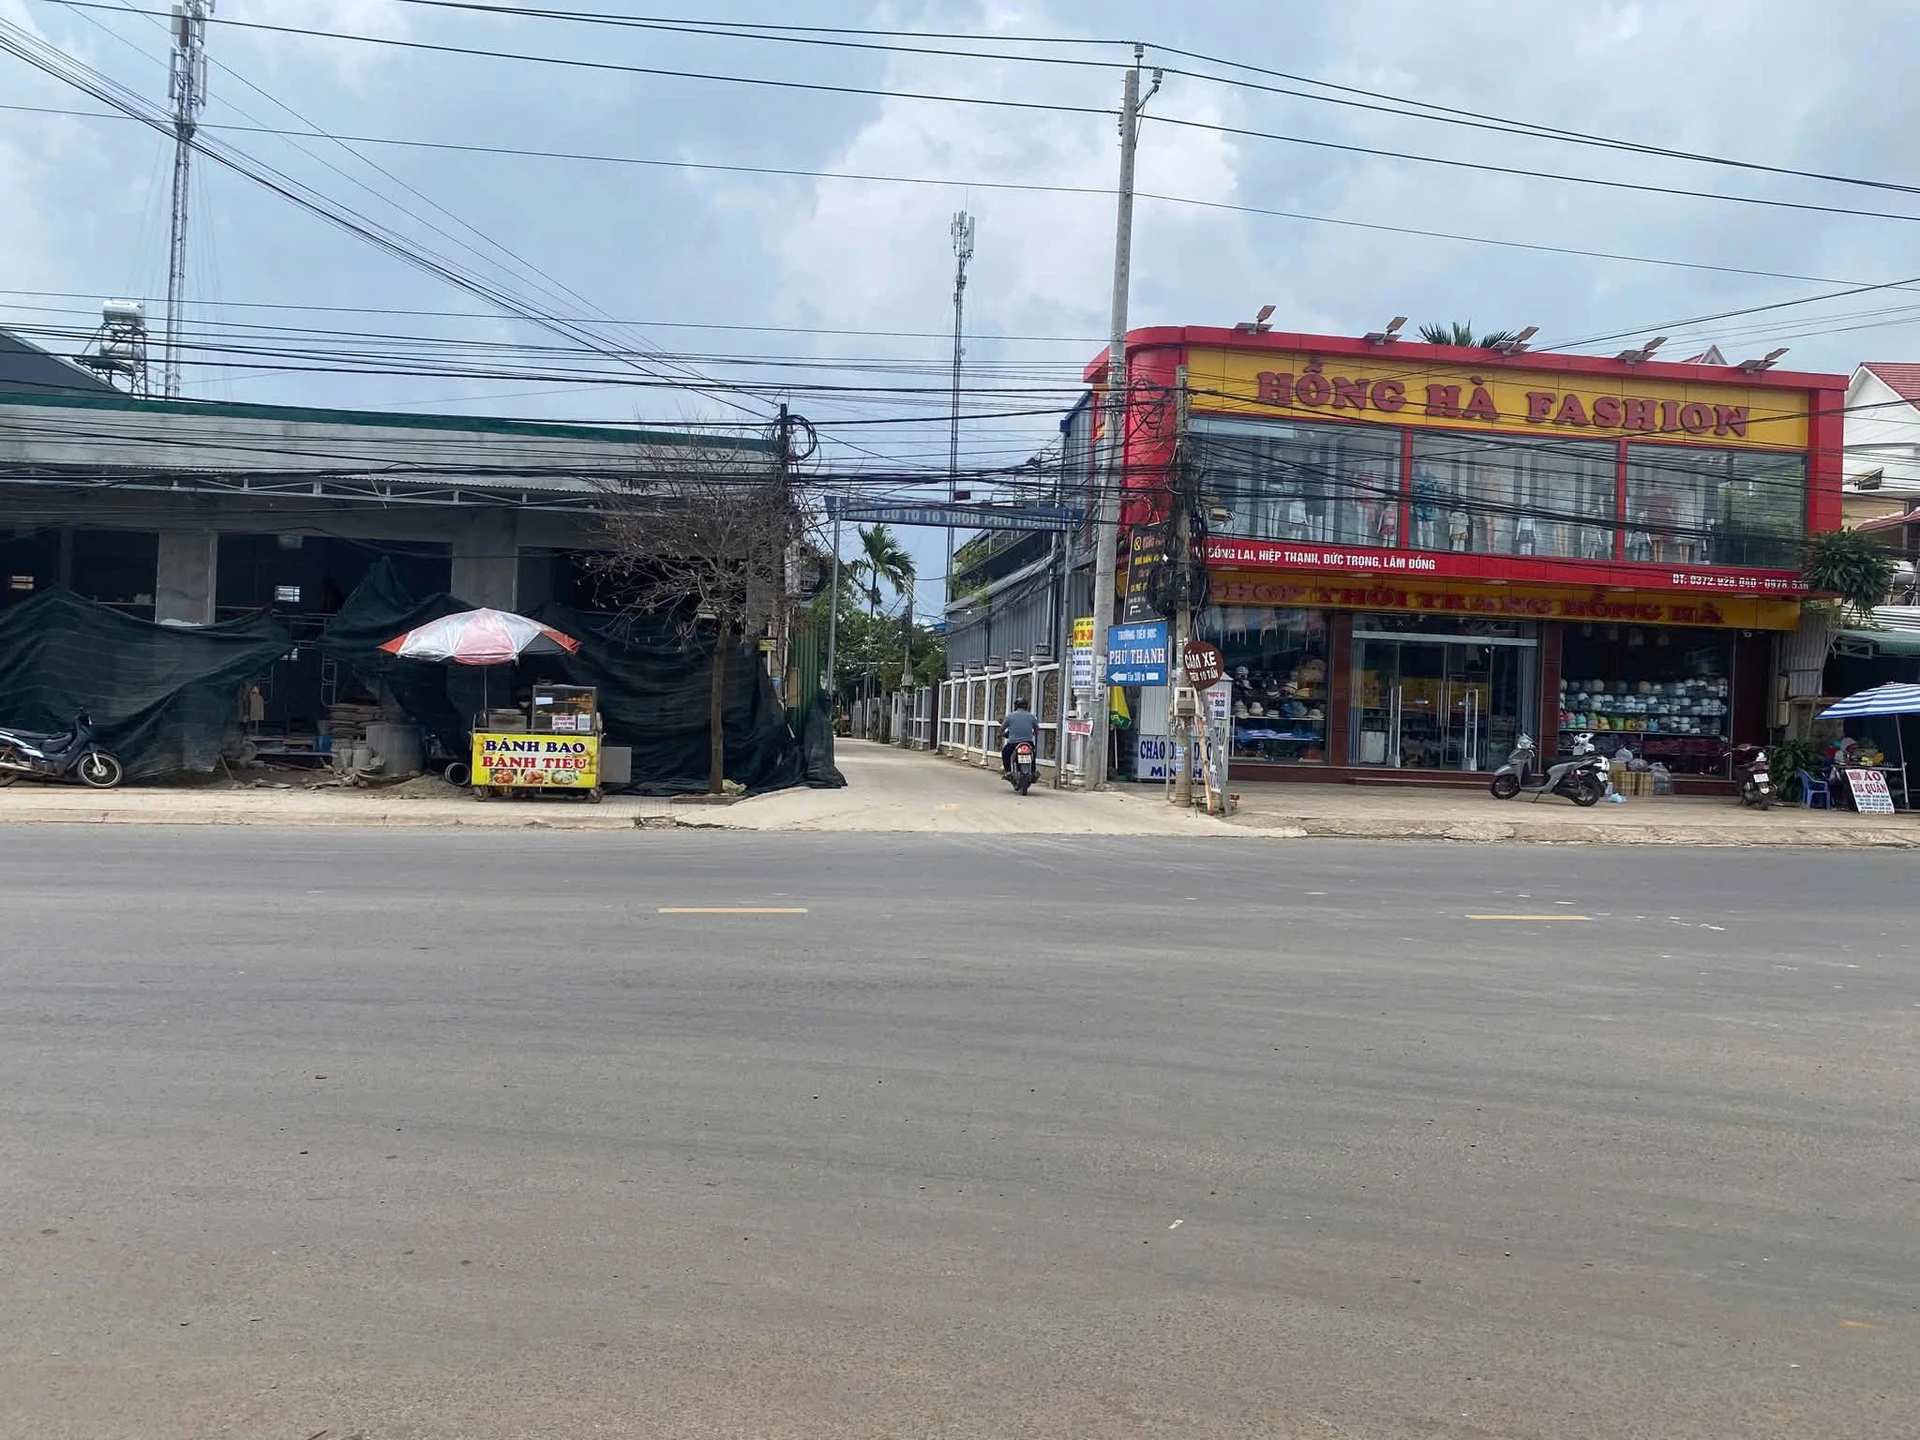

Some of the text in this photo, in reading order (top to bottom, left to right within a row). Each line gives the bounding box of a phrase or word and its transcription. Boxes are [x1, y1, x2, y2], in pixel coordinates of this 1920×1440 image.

[1257, 357, 1749, 437] HỒNG HÀ FASHION
[1259, 548, 1281, 563] HIỆP
[1285, 551, 1320, 565] THẠNH,
[1323, 551, 1344, 565] ĐỨC
[1346, 554, 1381, 569] TRỌNG,
[1383, 555, 1405, 569] LÂM
[1408, 554, 1436, 570] ĐỒNG
[1109, 643, 1165, 668] PHÚ THẠNH
[1201, 651, 1217, 668] XE
[485, 738, 585, 753] BÁNH BAO
[1140, 736, 1166, 760] CHÁO
[482, 754, 587, 769] BÁNH TIÊU
